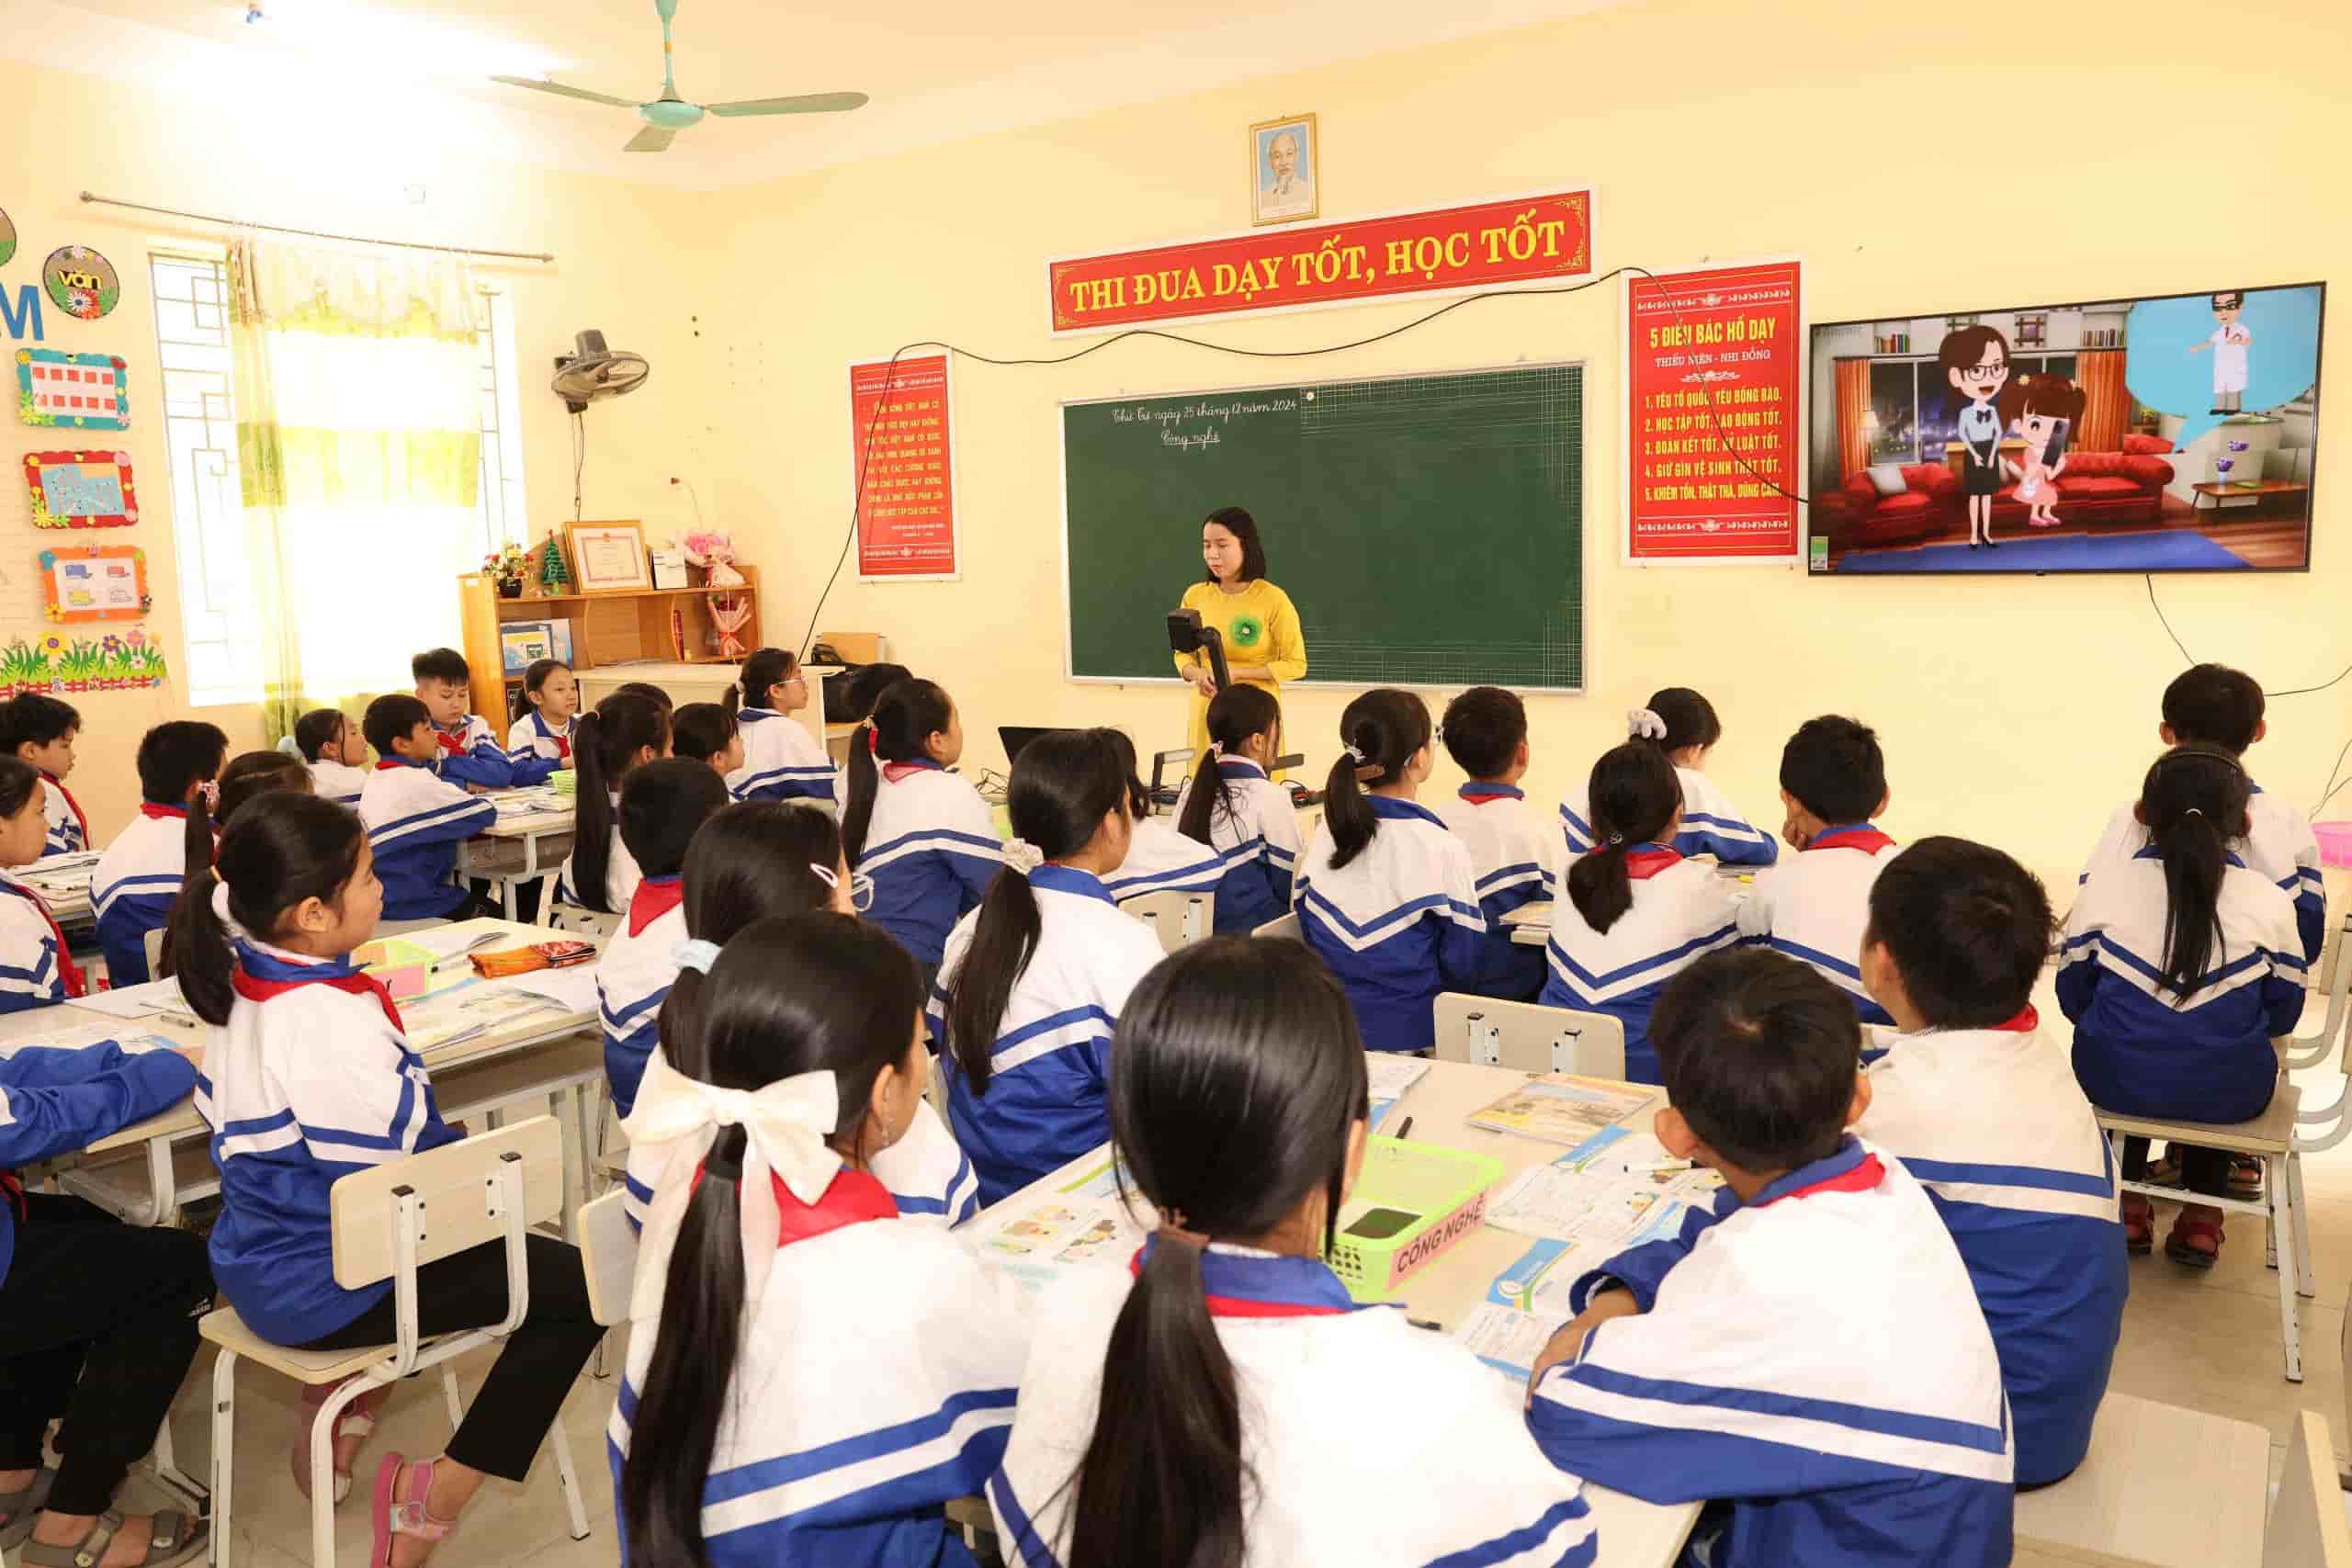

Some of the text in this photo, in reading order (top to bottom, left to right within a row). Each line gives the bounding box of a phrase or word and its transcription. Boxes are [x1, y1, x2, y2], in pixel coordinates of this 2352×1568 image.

[1069, 209, 1566, 312] THI ĐUA DẠY TỐT, HỌC TỐT
[1650, 313, 1776, 348] 5 ĐIỀU BÁC HỒ DẠY
[1720, 352, 1738, 363] NHI
[1232, 401, 1241, 413] 12
[1272, 399, 1298, 412] 2024
[1707, 460, 1731, 476] SINH
[1397, 1229, 1442, 1272] CÔNG
